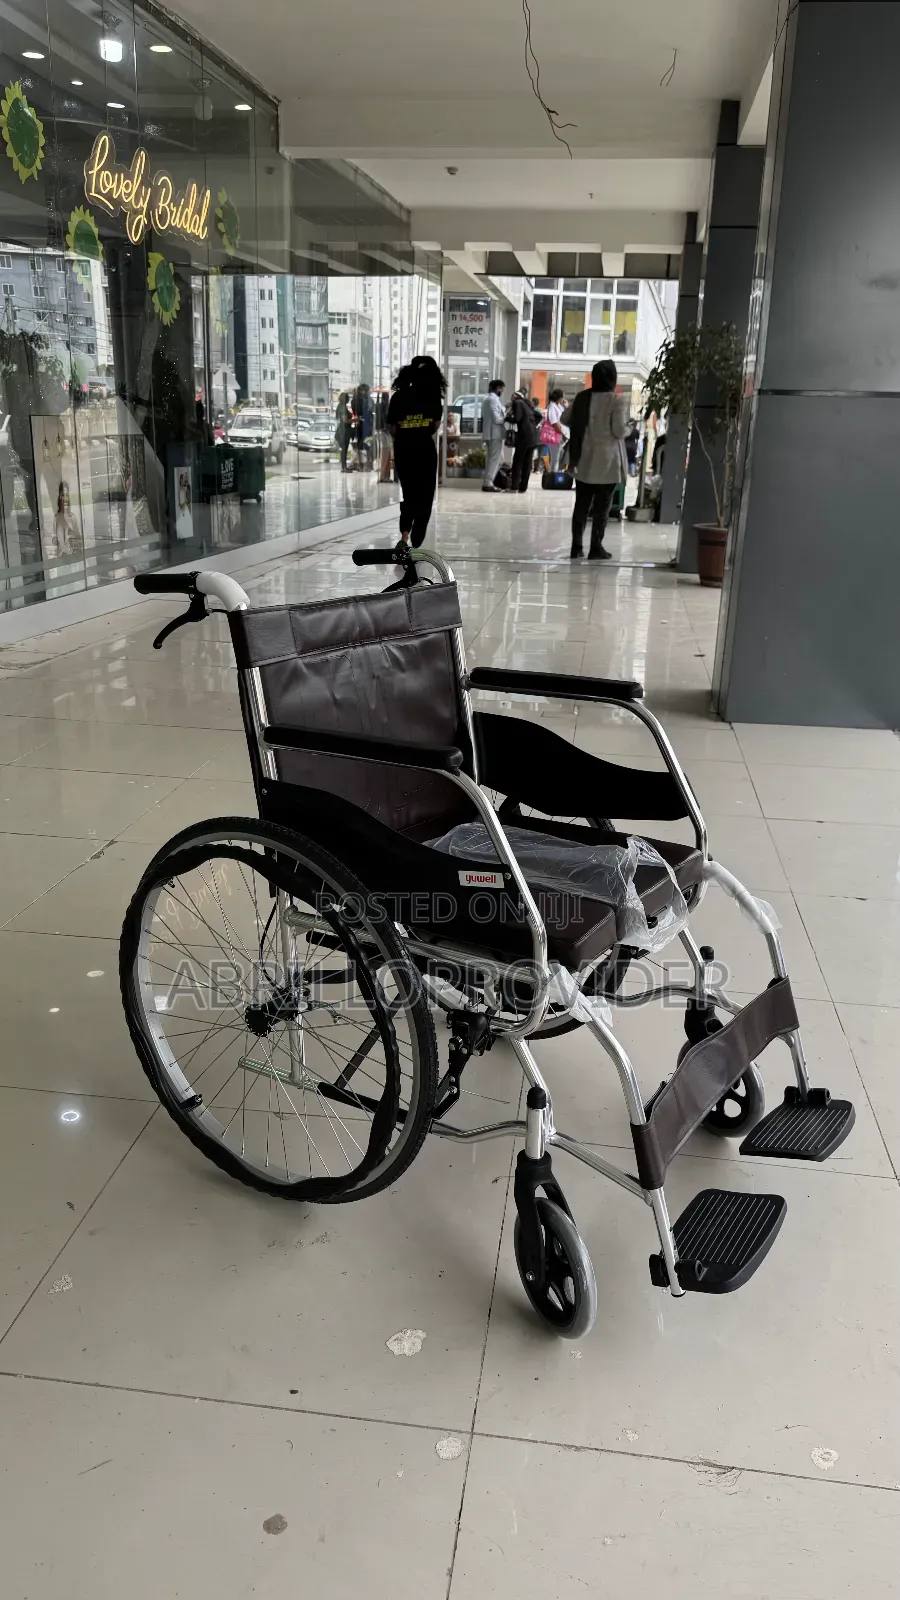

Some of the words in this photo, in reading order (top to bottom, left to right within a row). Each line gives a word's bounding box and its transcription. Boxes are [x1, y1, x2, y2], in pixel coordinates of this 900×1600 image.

[89, 135, 151, 242] Lovely
[155, 176, 210, 240] Bridal
[460, 313, 484, 323] 14,500
[465, 874, 497, 885] yuwell
